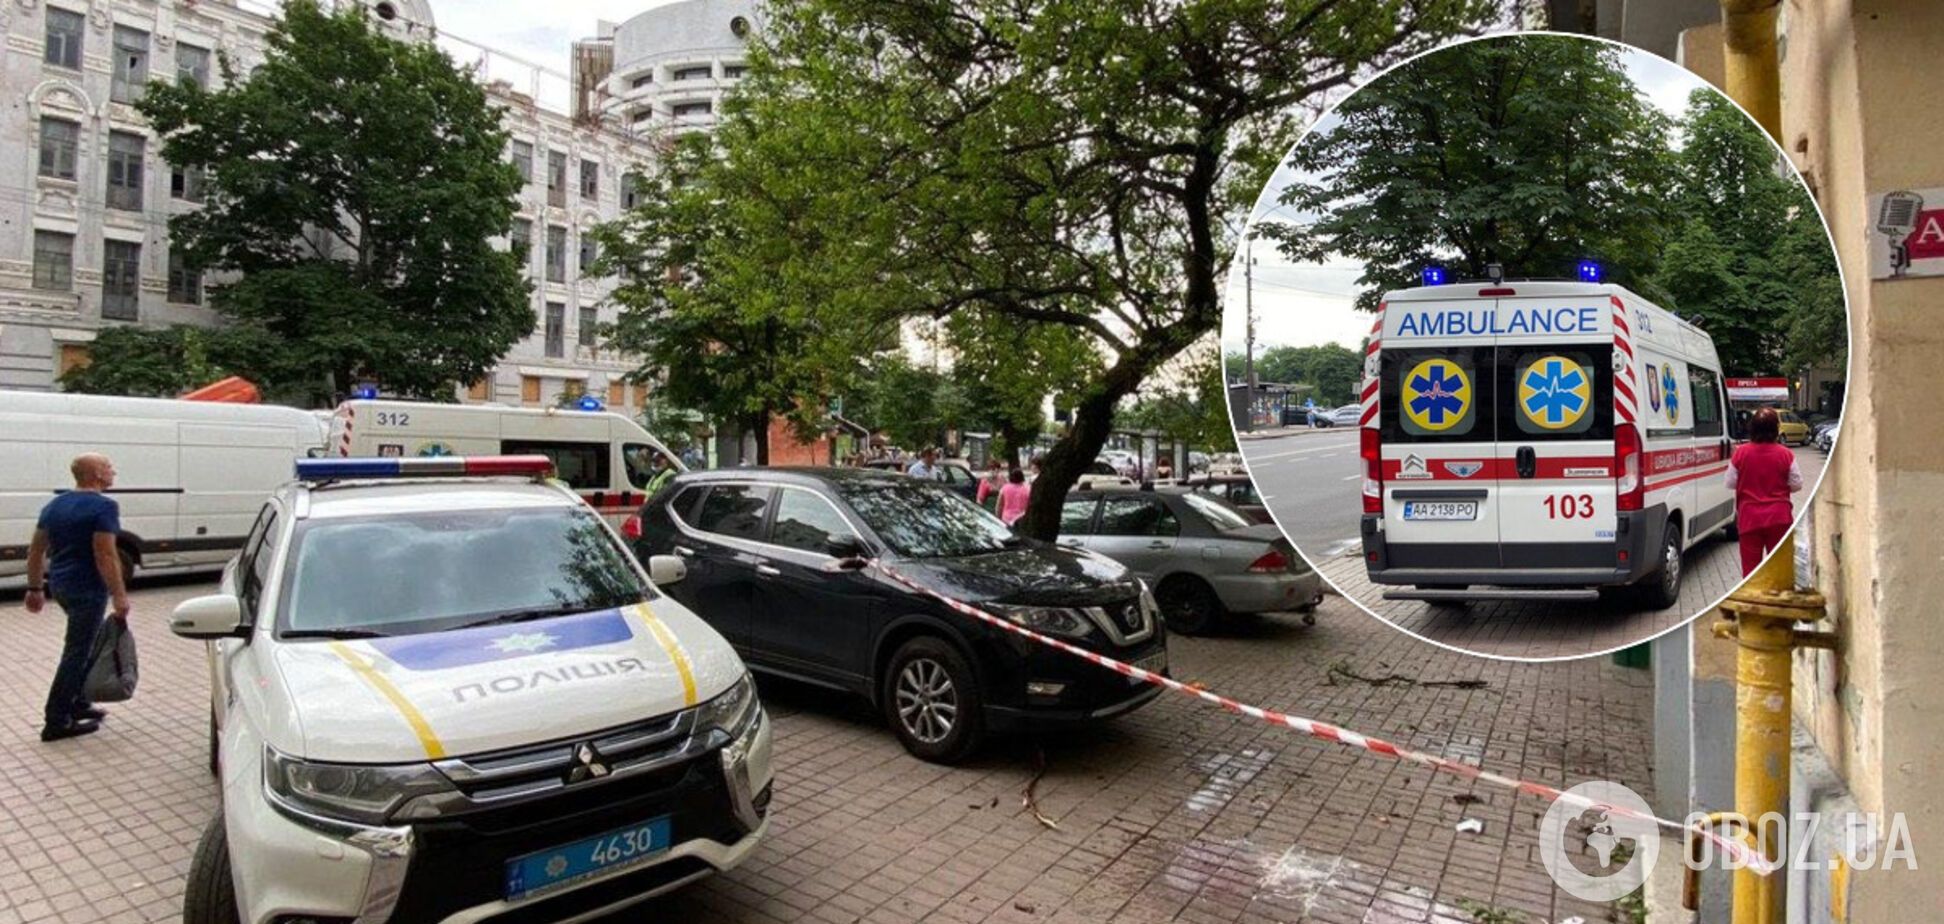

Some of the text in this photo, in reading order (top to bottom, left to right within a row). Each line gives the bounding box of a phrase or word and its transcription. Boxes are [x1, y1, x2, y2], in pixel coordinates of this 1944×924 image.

[1397, 308, 1598, 336] AMBULANCE
[1635, 310, 1652, 334] 312
[377, 412, 409, 426] 312
[1413, 503, 1473, 516] AA 2138 PO
[1543, 494, 1594, 519] 103
[453, 658, 647, 702] ПОЛІЦІЯ
[591, 827, 651, 865] 4630
